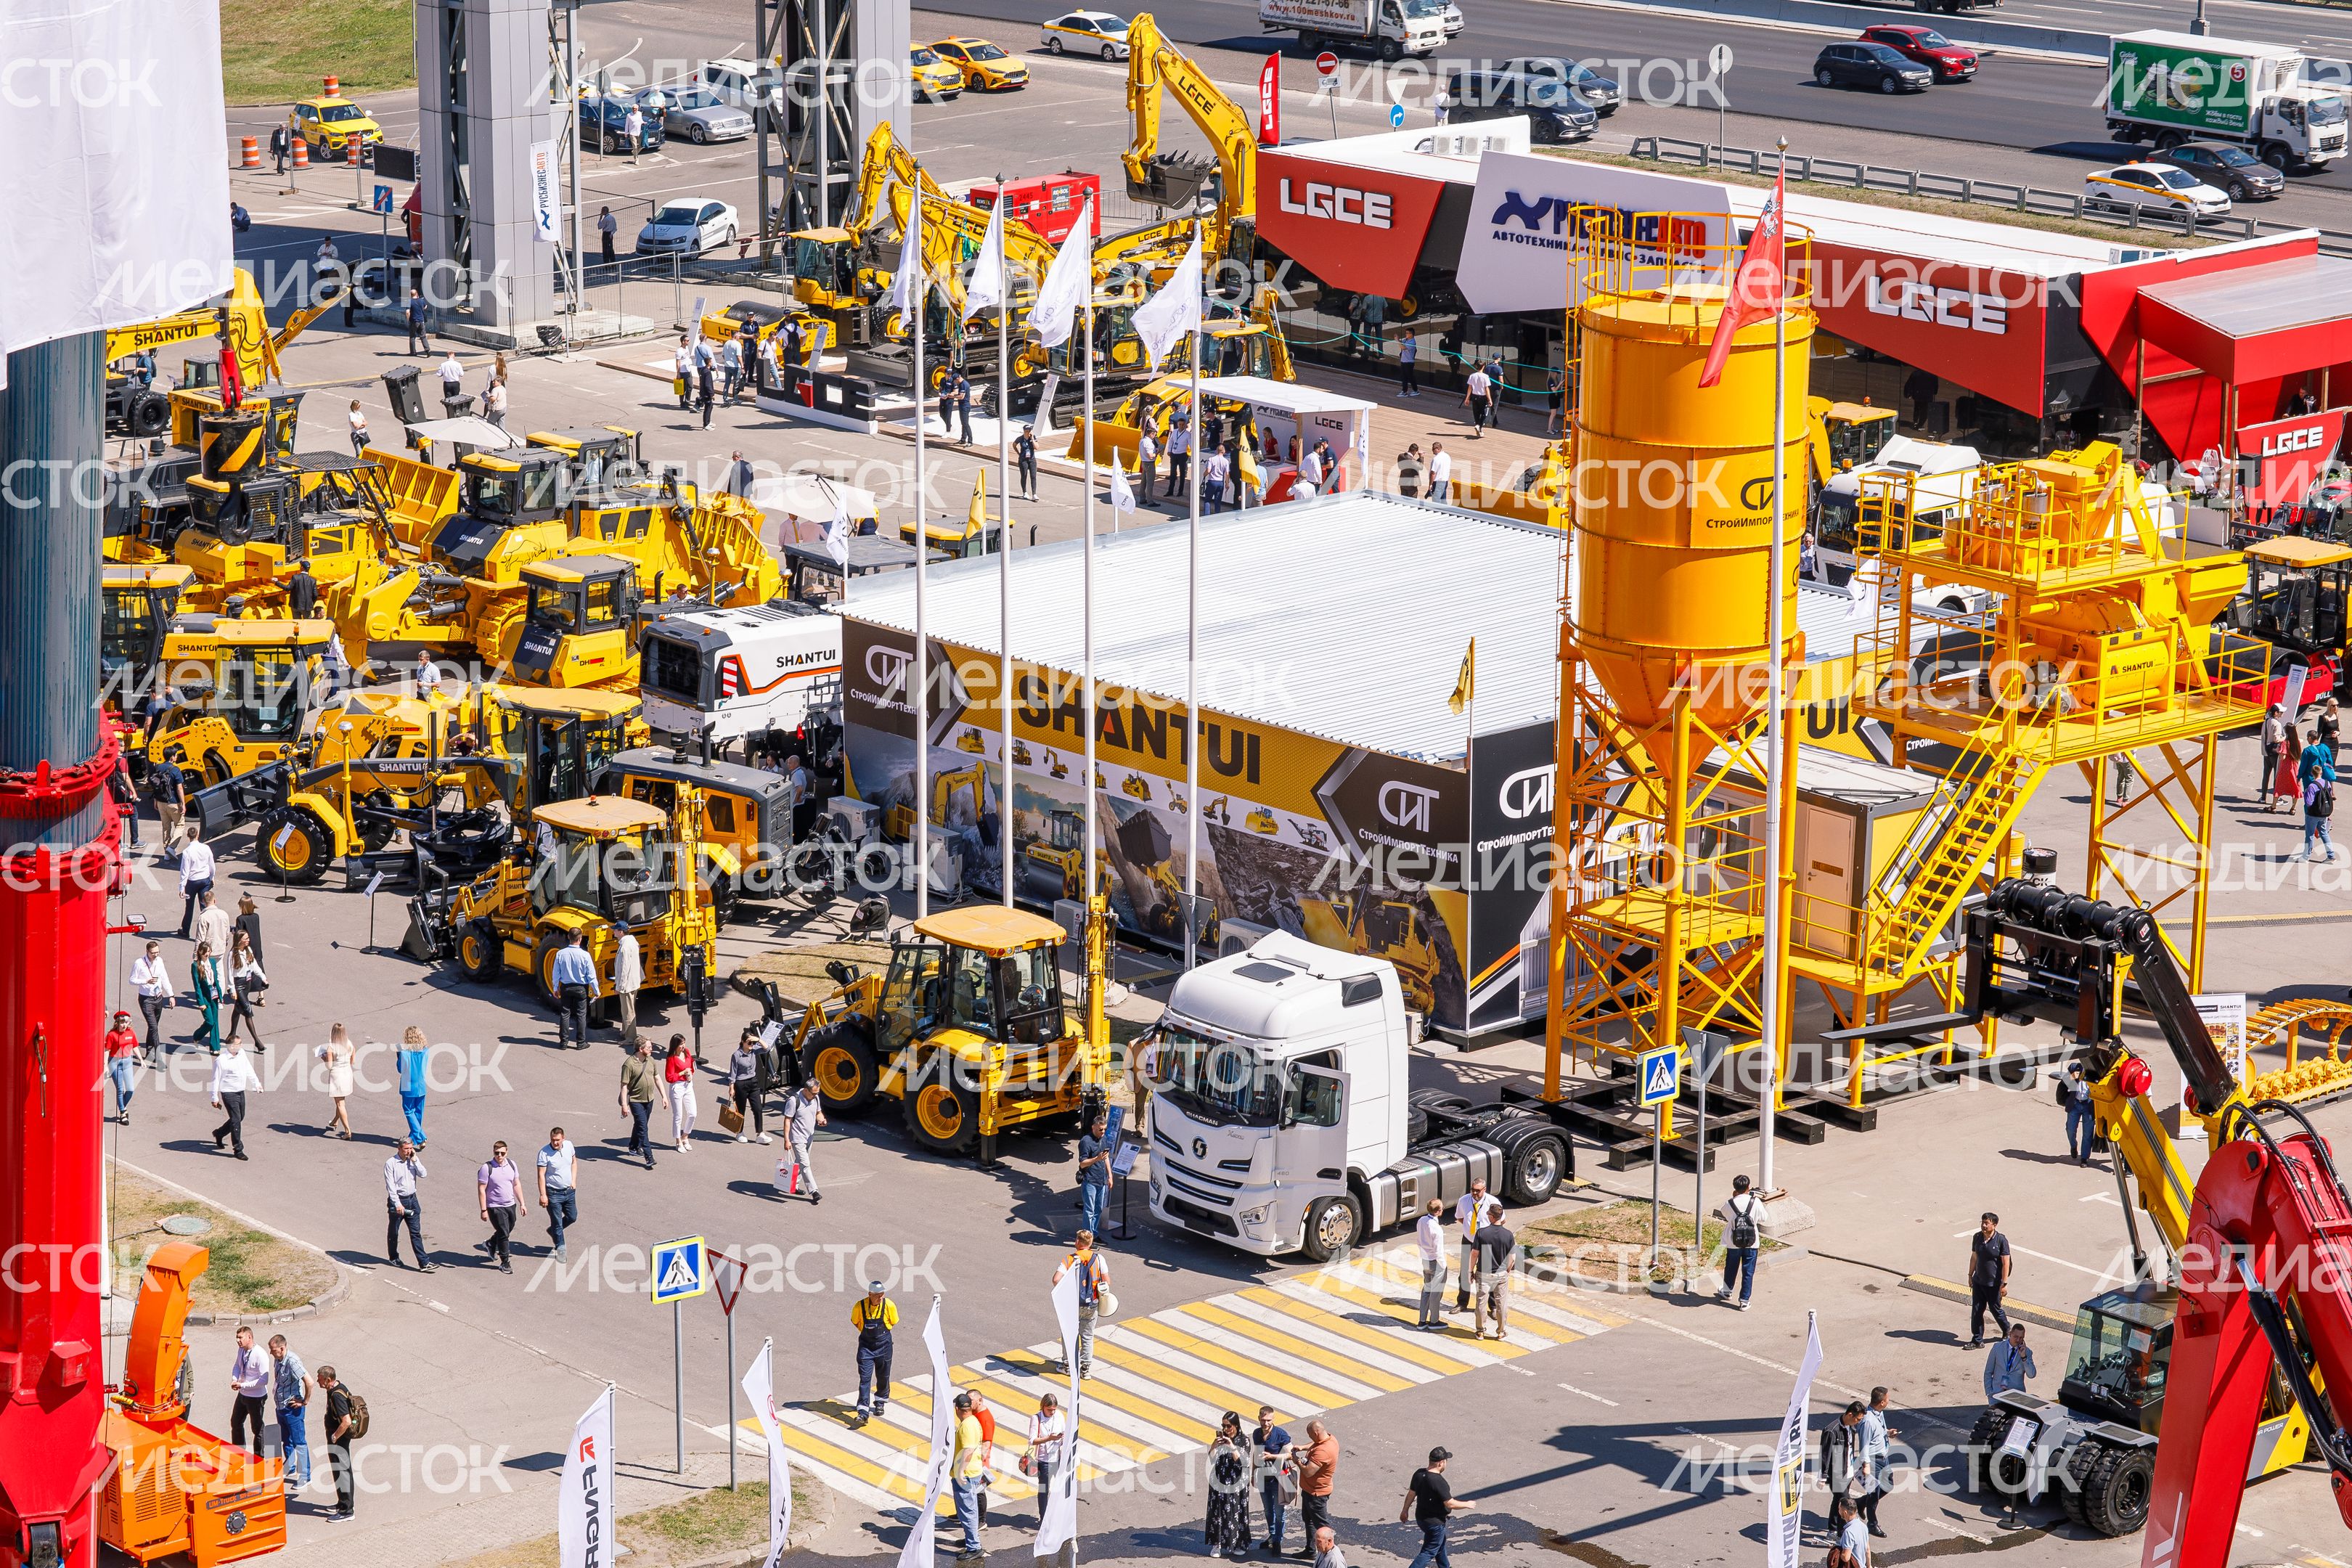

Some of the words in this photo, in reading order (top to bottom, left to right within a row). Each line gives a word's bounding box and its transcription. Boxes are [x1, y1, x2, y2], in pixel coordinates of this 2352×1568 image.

[1268, 4, 1356, 21] www.100meshkov.ru
[1178, 75, 1214, 115] LGCE
[1262, 66, 1274, 131] LGCE
[1281, 177, 1394, 230] LGCE
[1138, 229, 1163, 242] LGCE
[1869, 275, 2009, 335] LGCE
[134, 326, 200, 346] SHANTUI
[756, 357, 877, 422] LGCE
[1315, 416, 1344, 431] LGCE
[2261, 425, 2324, 459] LGCE
[459, 534, 485, 545] SHANTUI
[524, 641, 554, 656] SHANTUI
[776, 649, 836, 668] SHANTUI
[2121, 660, 2154, 674] SHANTUI
[2316, 690, 2332, 701] BULL
[1018, 674, 1261, 786] SHANTUI
[378, 763, 422, 772] SHANTUI
[1185, 1111, 1219, 1127] SHACMAN
